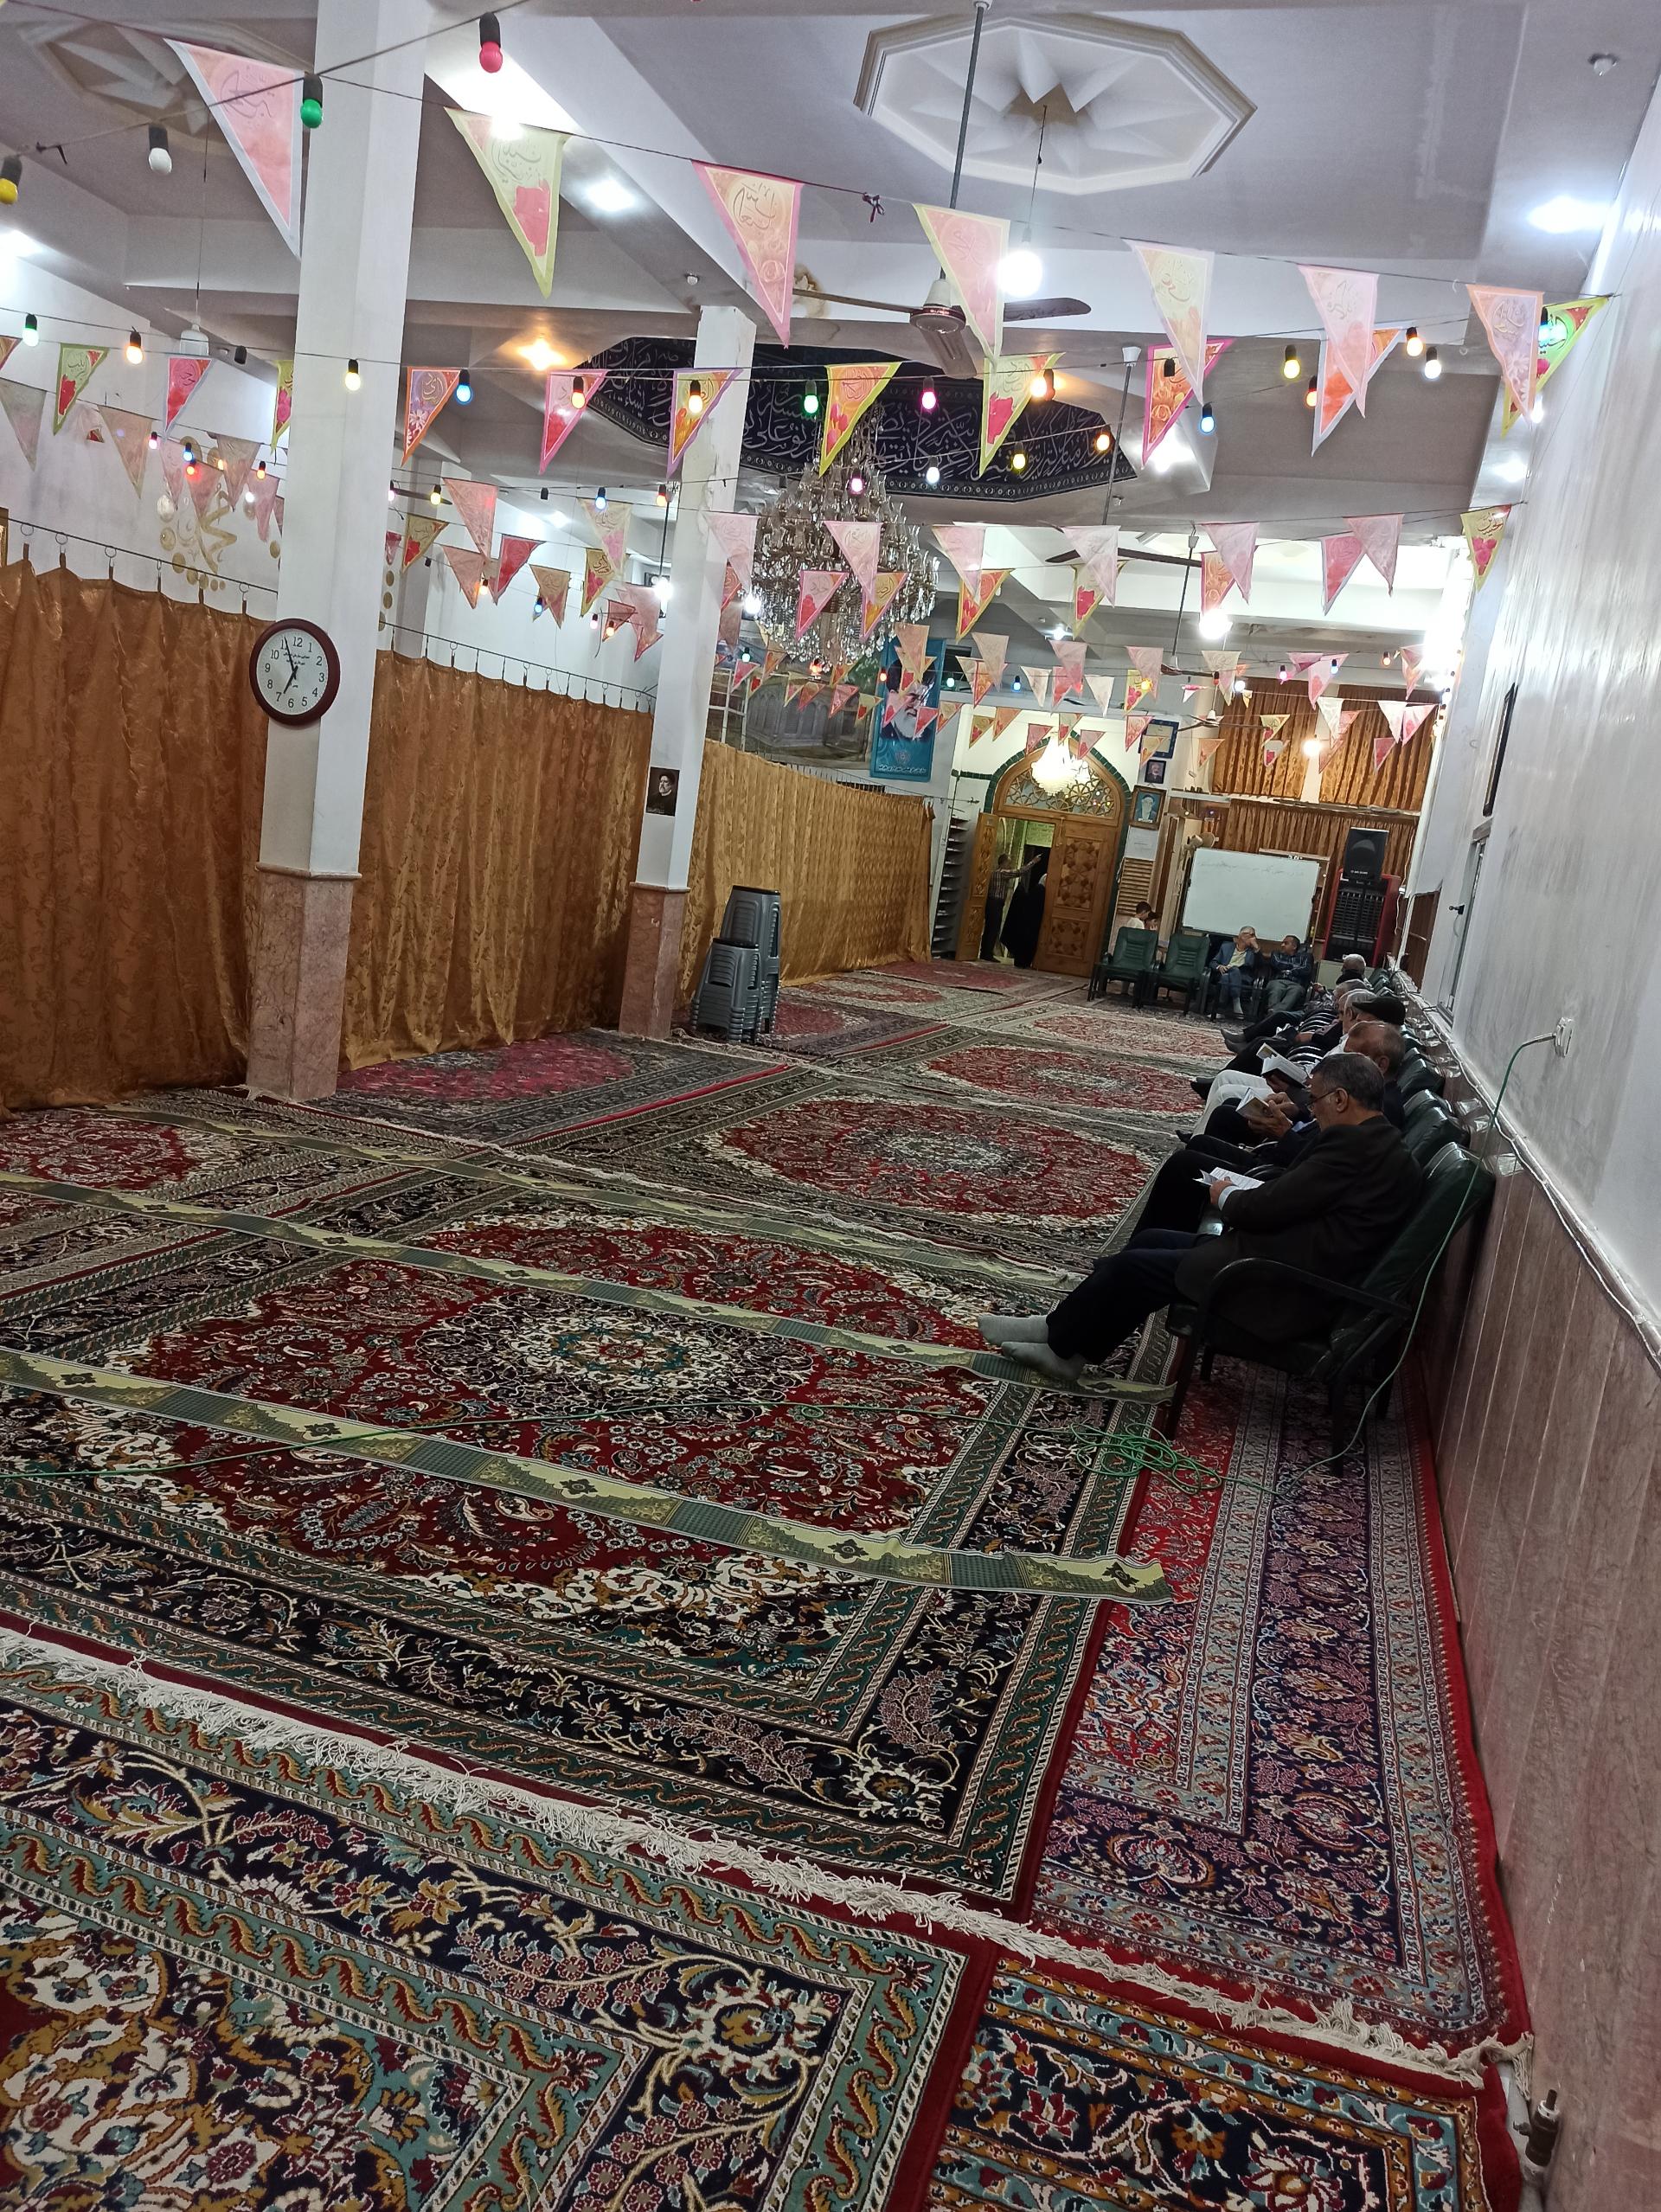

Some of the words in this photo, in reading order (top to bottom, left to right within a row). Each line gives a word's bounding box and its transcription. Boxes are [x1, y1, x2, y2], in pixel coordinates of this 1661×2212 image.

[292, 636, 303, 647] 12
[308, 642, 312, 652] 1
[270, 650, 279, 659] 10
[316, 656, 323, 666] 2
[264, 663, 271, 672] 9
[318, 672, 325, 683] 3
[266, 678, 273, 689] 8
[275, 691, 282, 702] 7
[312, 687, 318, 697] 4
[287, 697, 295, 708] 6
[301, 696, 308, 707] 5
